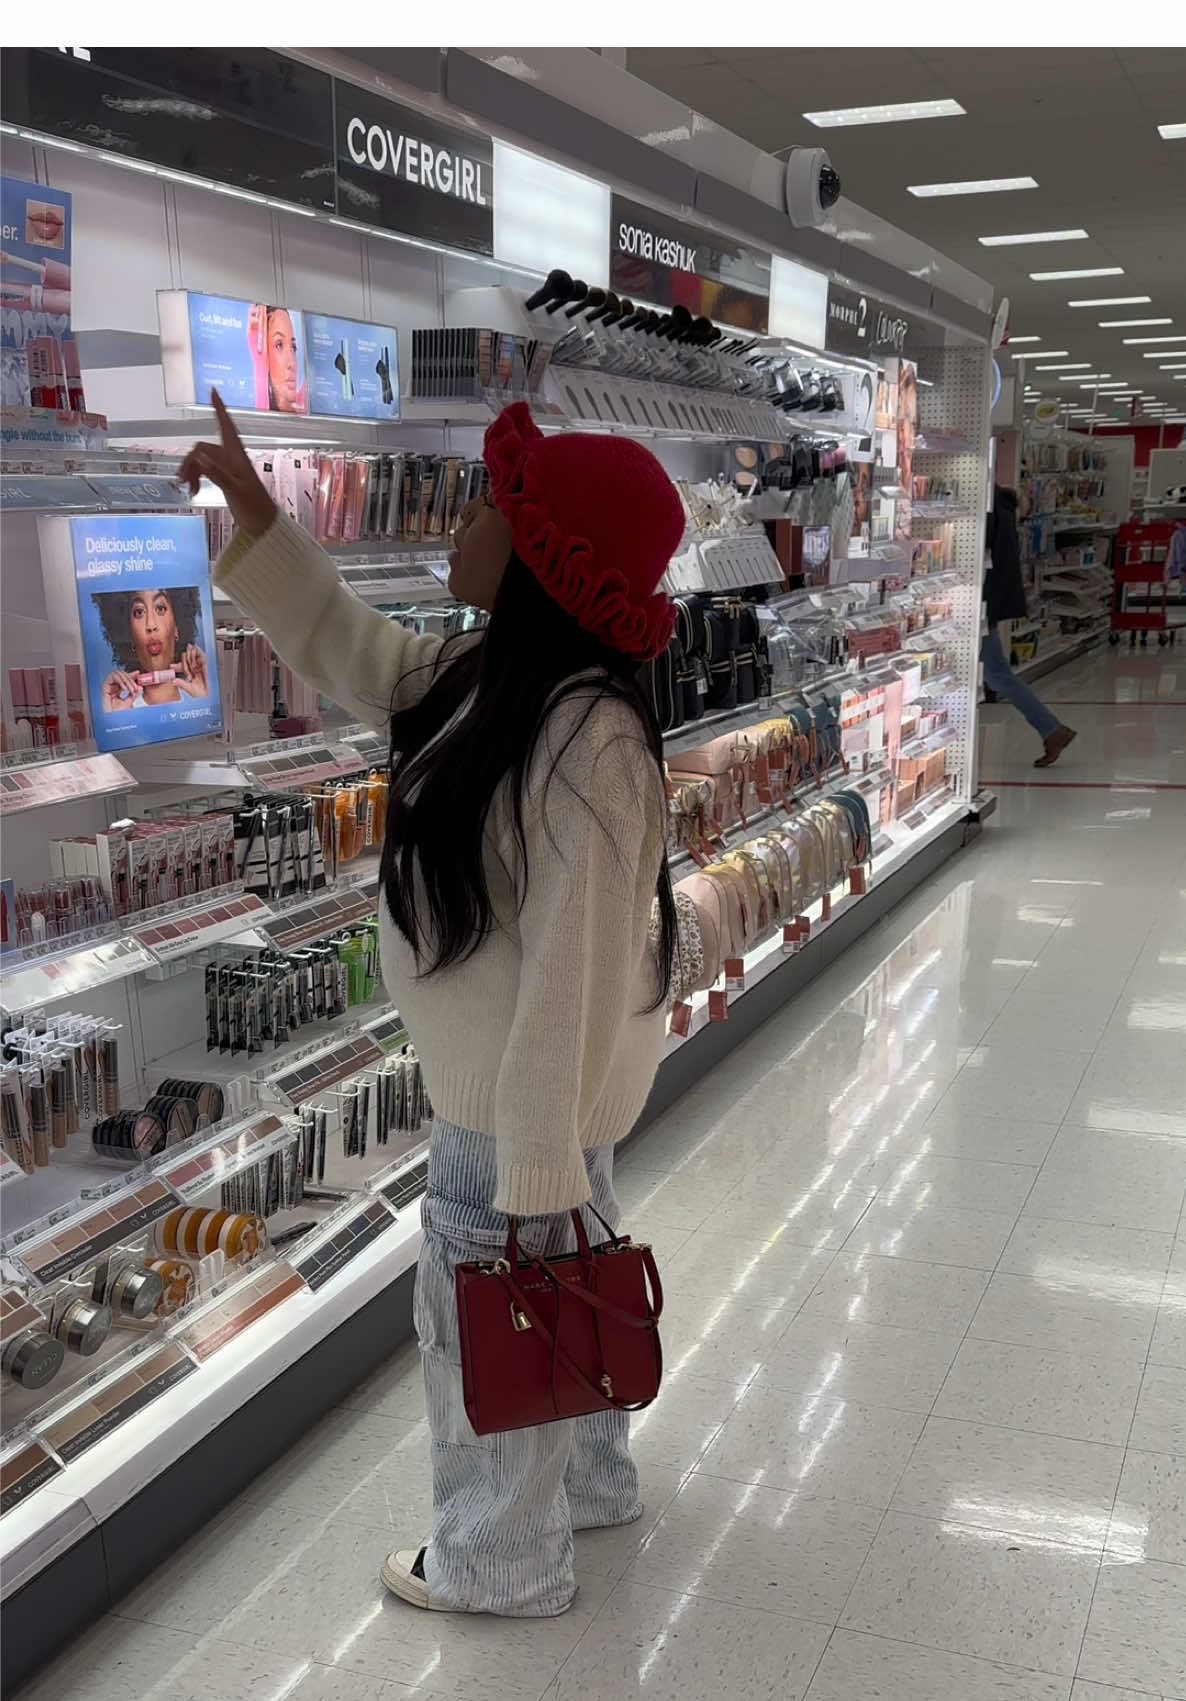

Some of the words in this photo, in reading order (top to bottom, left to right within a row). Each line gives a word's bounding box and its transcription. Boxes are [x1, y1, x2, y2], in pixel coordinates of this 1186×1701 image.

[347, 117, 486, 206] COVERGIRL
[0, 223, 18, 241] er.
[86, 536, 144, 555] Deliciously
[145, 536, 177, 553] clean,
[87, 558, 123, 577] glassy
[124, 556, 154, 573] shine
